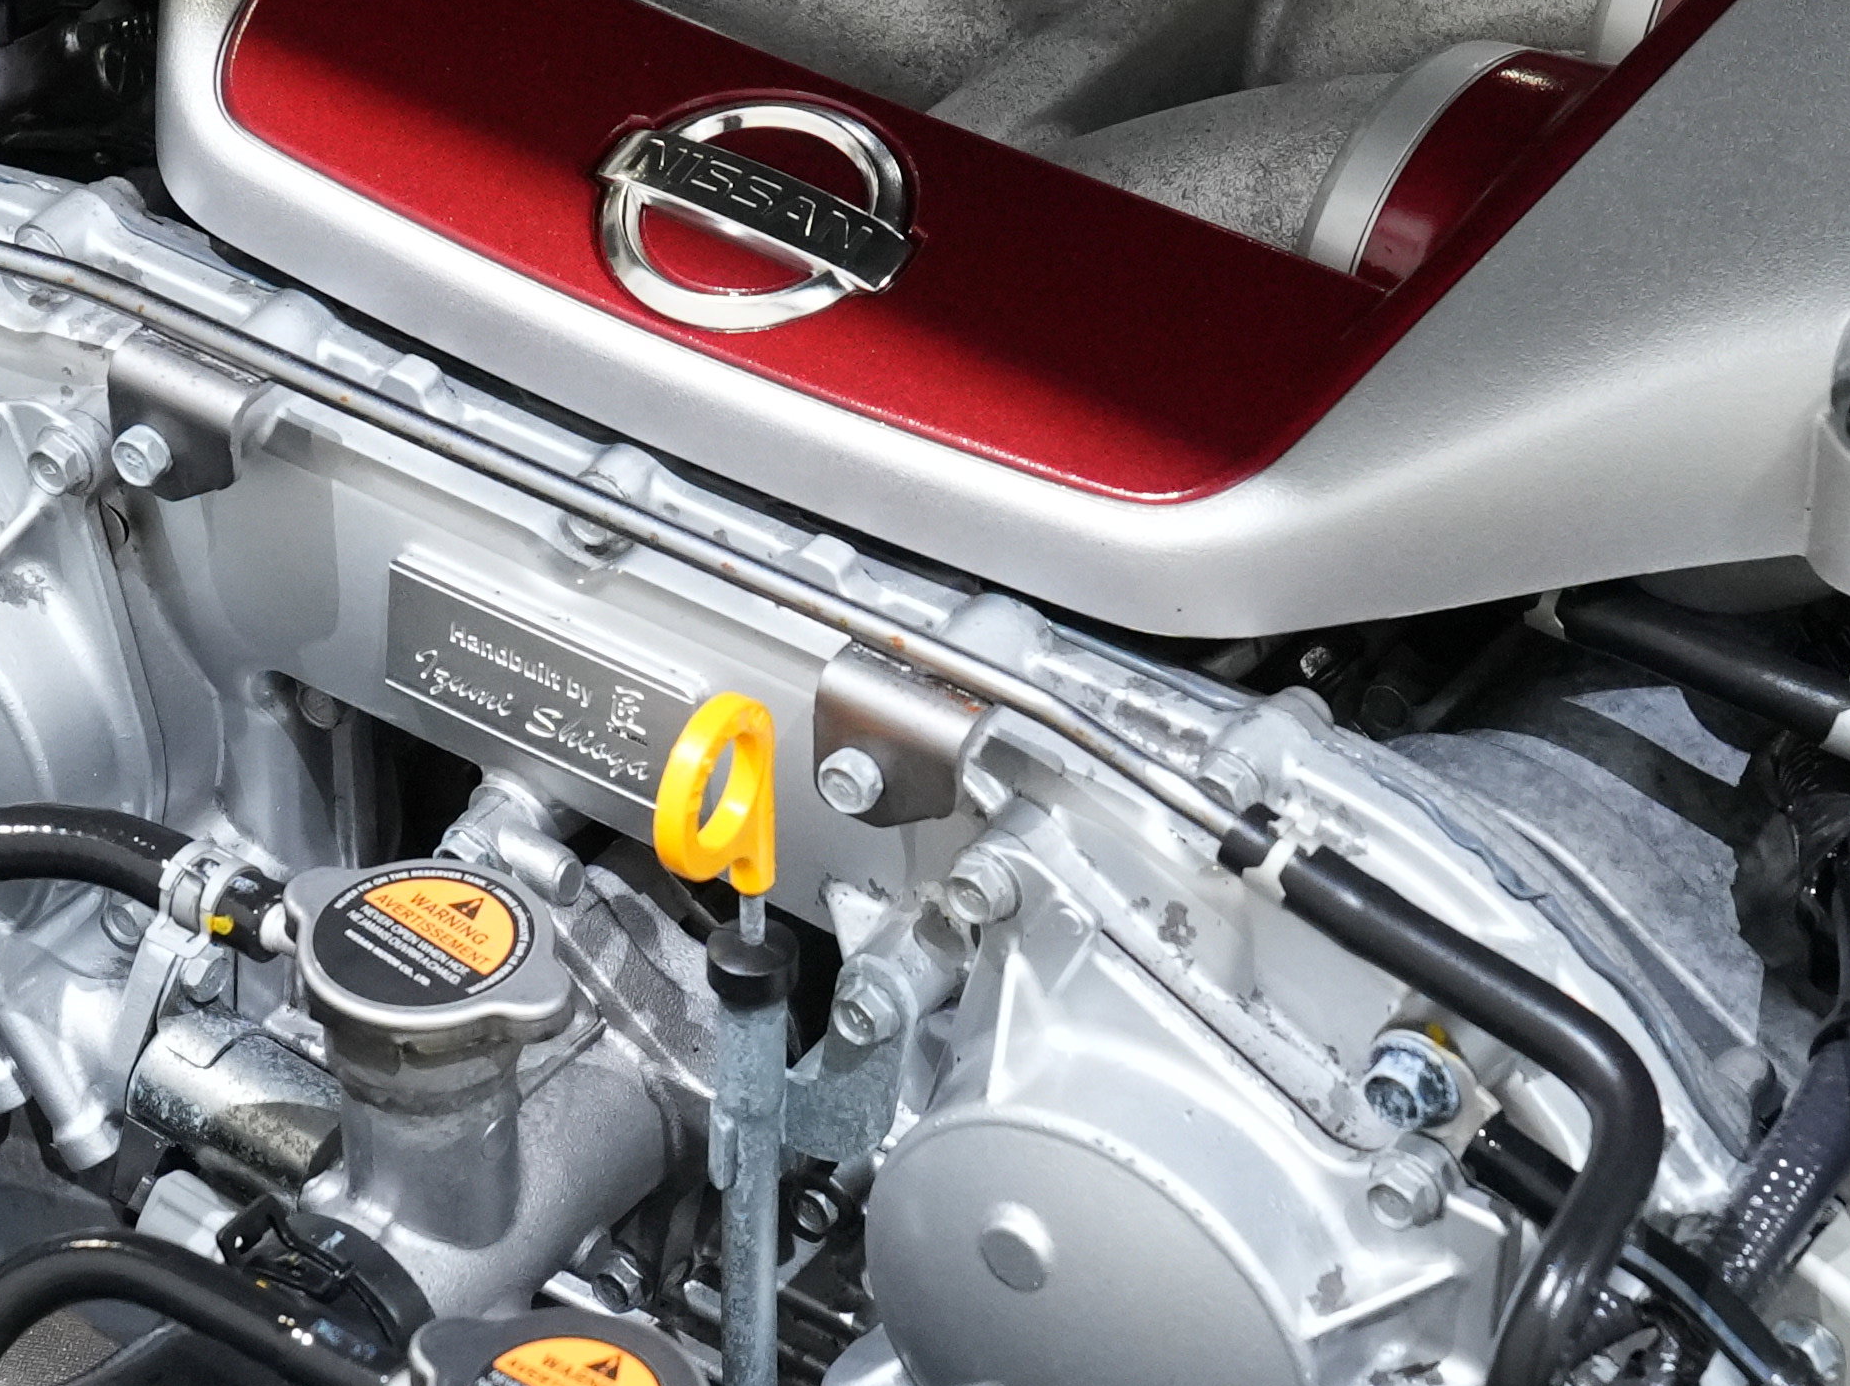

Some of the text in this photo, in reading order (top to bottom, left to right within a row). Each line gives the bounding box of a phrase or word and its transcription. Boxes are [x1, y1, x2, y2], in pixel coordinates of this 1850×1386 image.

[628, 137, 874, 251] NISSAN
[415, 649, 515, 717] Izumi
[449, 621, 594, 707] Handbuilt by
[360, 904, 395, 929] NEVER
[391, 921, 421, 944] OPEN
[375, 894, 492, 965] AVERTISSEMENT
[410, 892, 489, 946] WARNING
